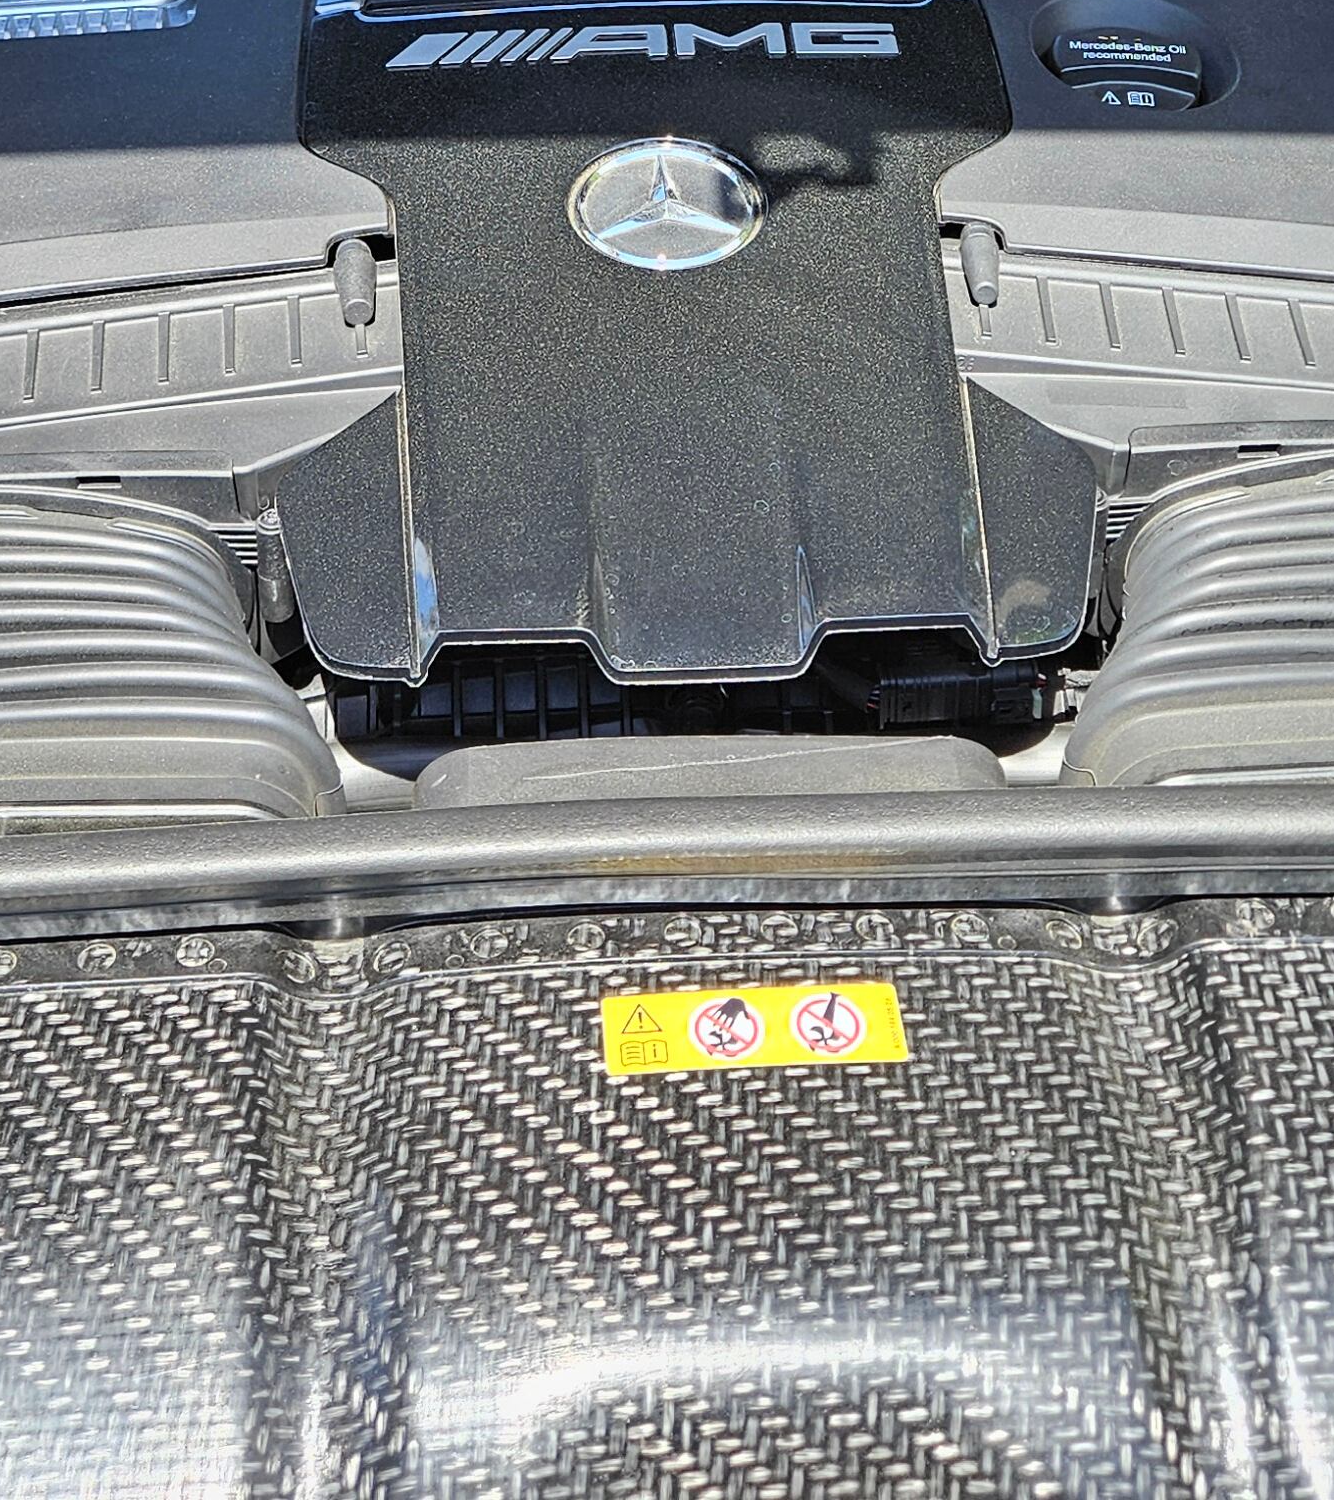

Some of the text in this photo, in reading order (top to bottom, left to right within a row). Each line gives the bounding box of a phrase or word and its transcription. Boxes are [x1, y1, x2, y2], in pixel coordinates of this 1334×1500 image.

[551, 22, 901, 63] AMG
[1069, 40, 1187, 54] Mercedes-Benz Oil
[1083, 51, 1172, 62] recommended
